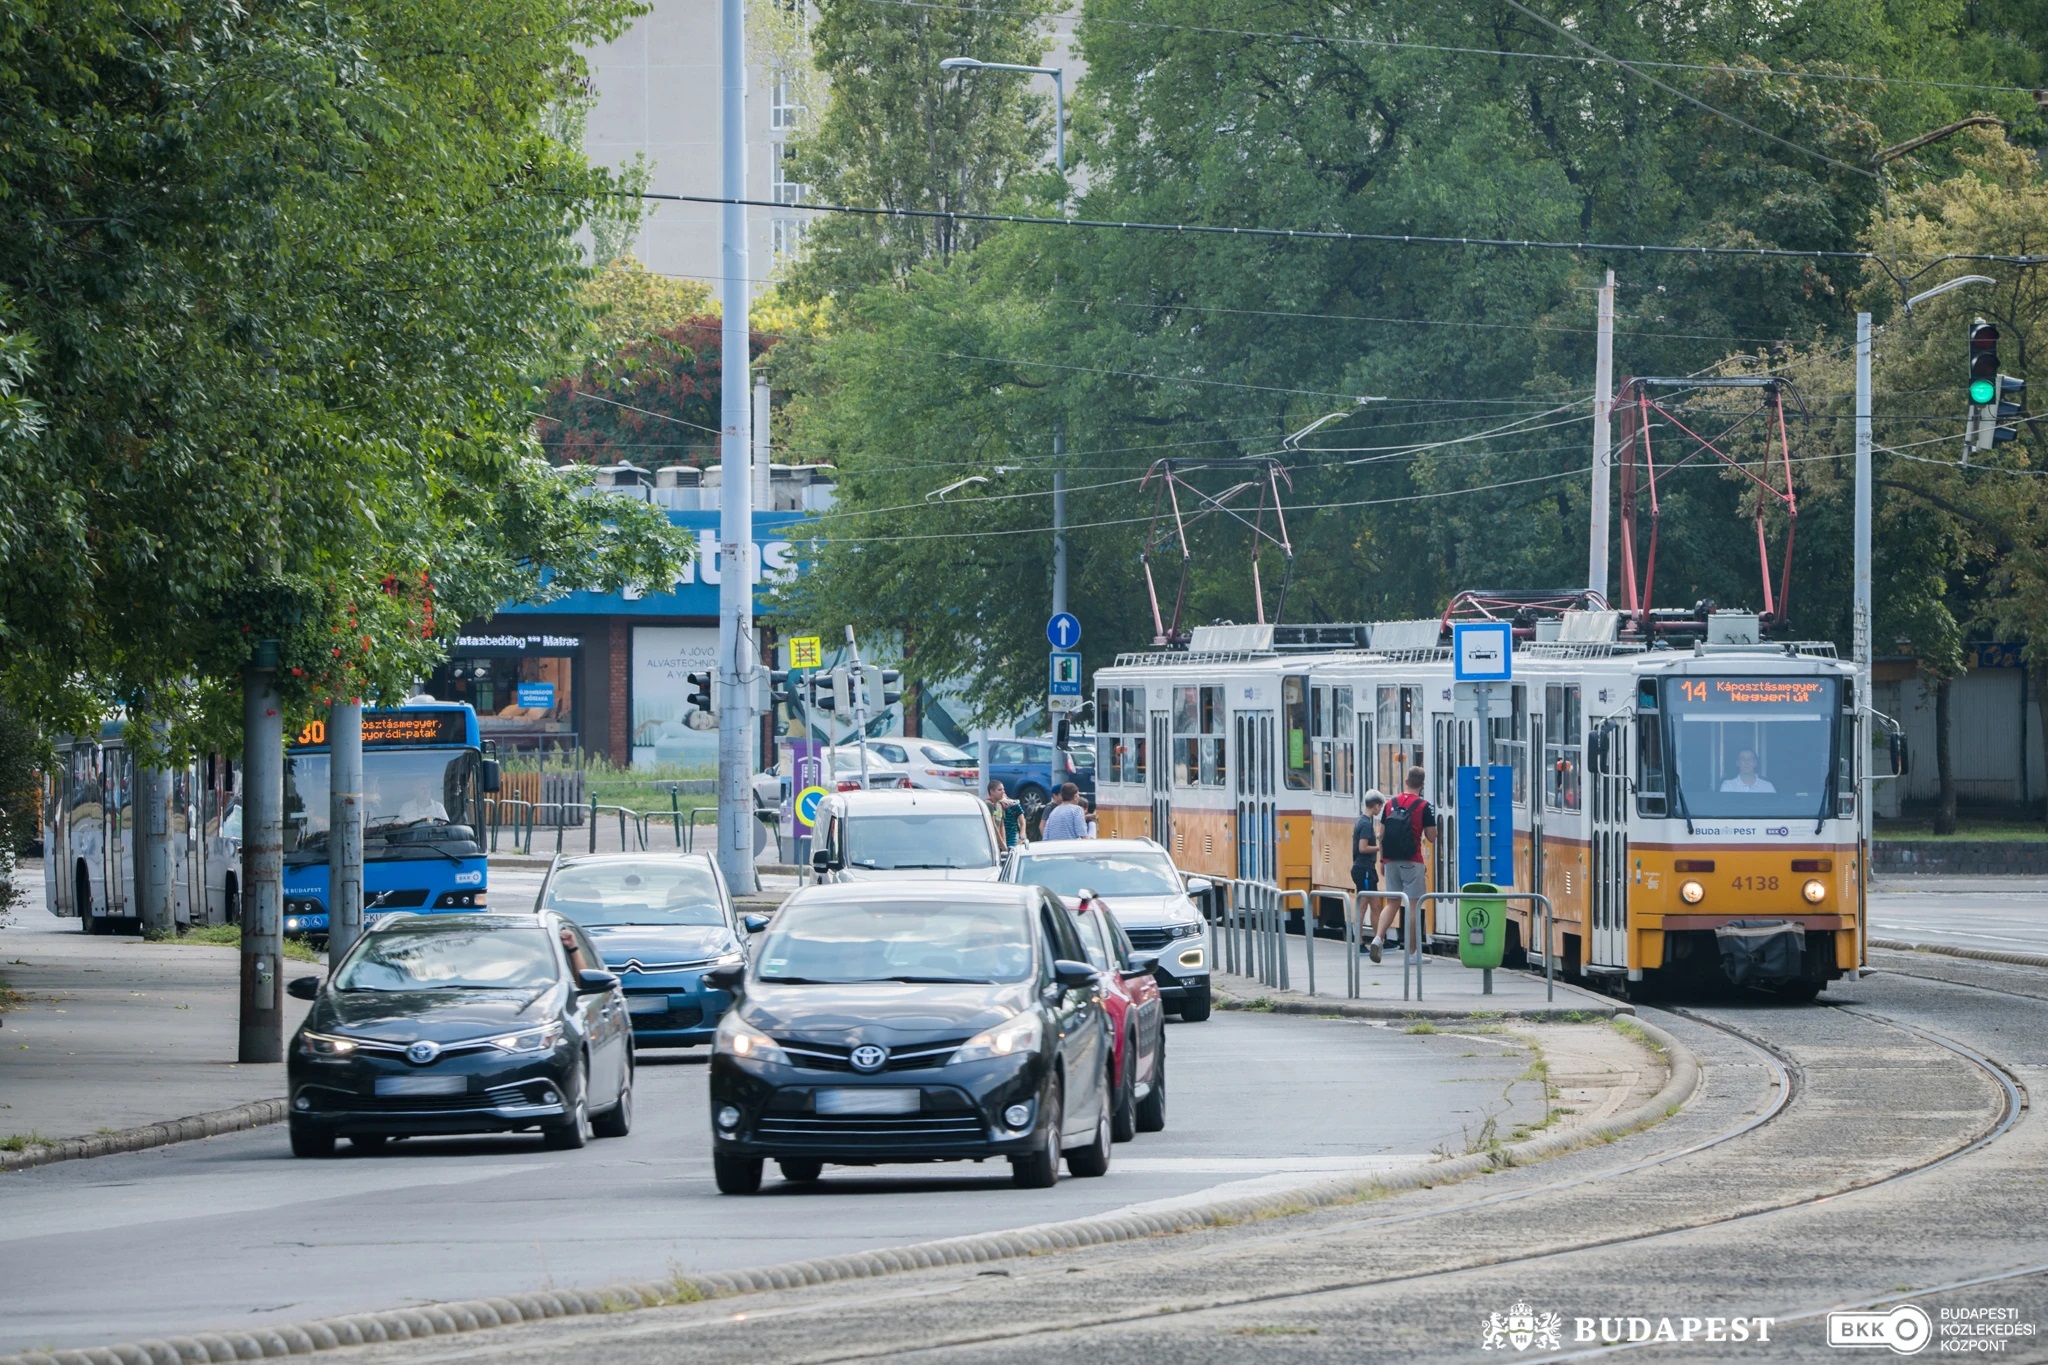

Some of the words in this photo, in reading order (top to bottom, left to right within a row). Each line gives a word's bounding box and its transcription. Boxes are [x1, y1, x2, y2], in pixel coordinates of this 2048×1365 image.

[680, 648, 687, 656] A
[667, 671, 674, 679] A
[1681, 681, 1707, 702] 14
[1716, 681, 1823, 693] Káposztásmegyer,
[1731, 692, 1790, 702] Megyeri
[1793, 692, 1809, 702] út
[361, 719, 443, 730] osztásmegyer,
[361, 728, 437, 741] gyoródi-patak
[1731, 876, 1779, 891] 4138
